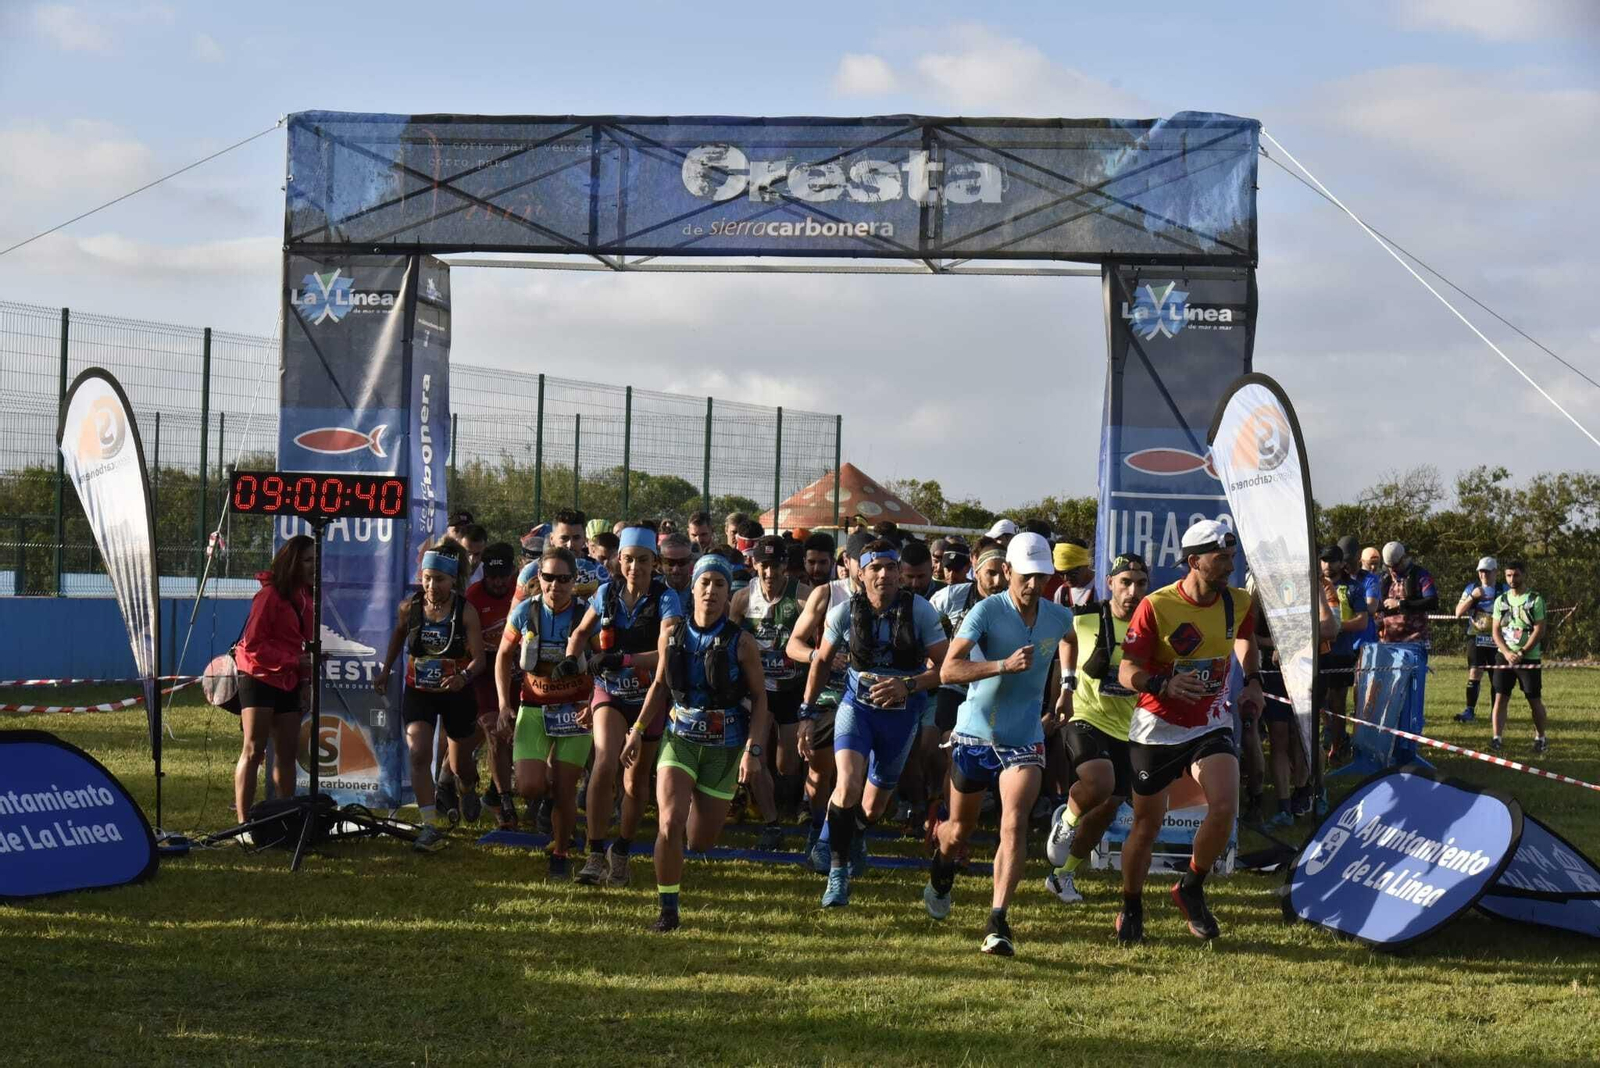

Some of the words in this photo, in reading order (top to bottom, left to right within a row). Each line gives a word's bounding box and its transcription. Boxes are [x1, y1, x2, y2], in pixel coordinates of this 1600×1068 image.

[682, 224, 704, 236] de
[709, 217, 894, 237] sierracarbonera
[291, 289, 317, 306] La
[335, 288, 394, 306] Línea
[1121, 302, 1149, 319] La
[1170, 302, 1233, 322] Línea
[234, 475, 403, 515] 09:00:40
[427, 668, 442, 678] 25
[615, 677, 640, 689] 105
[690, 719, 707, 732] 78
[20, 824, 59, 851] La
[1355, 815, 1490, 876] Ayuntamiento
[1341, 855, 1371, 884] de
[1364, 861, 1390, 891] La
[1385, 868, 1446, 908] Línea
